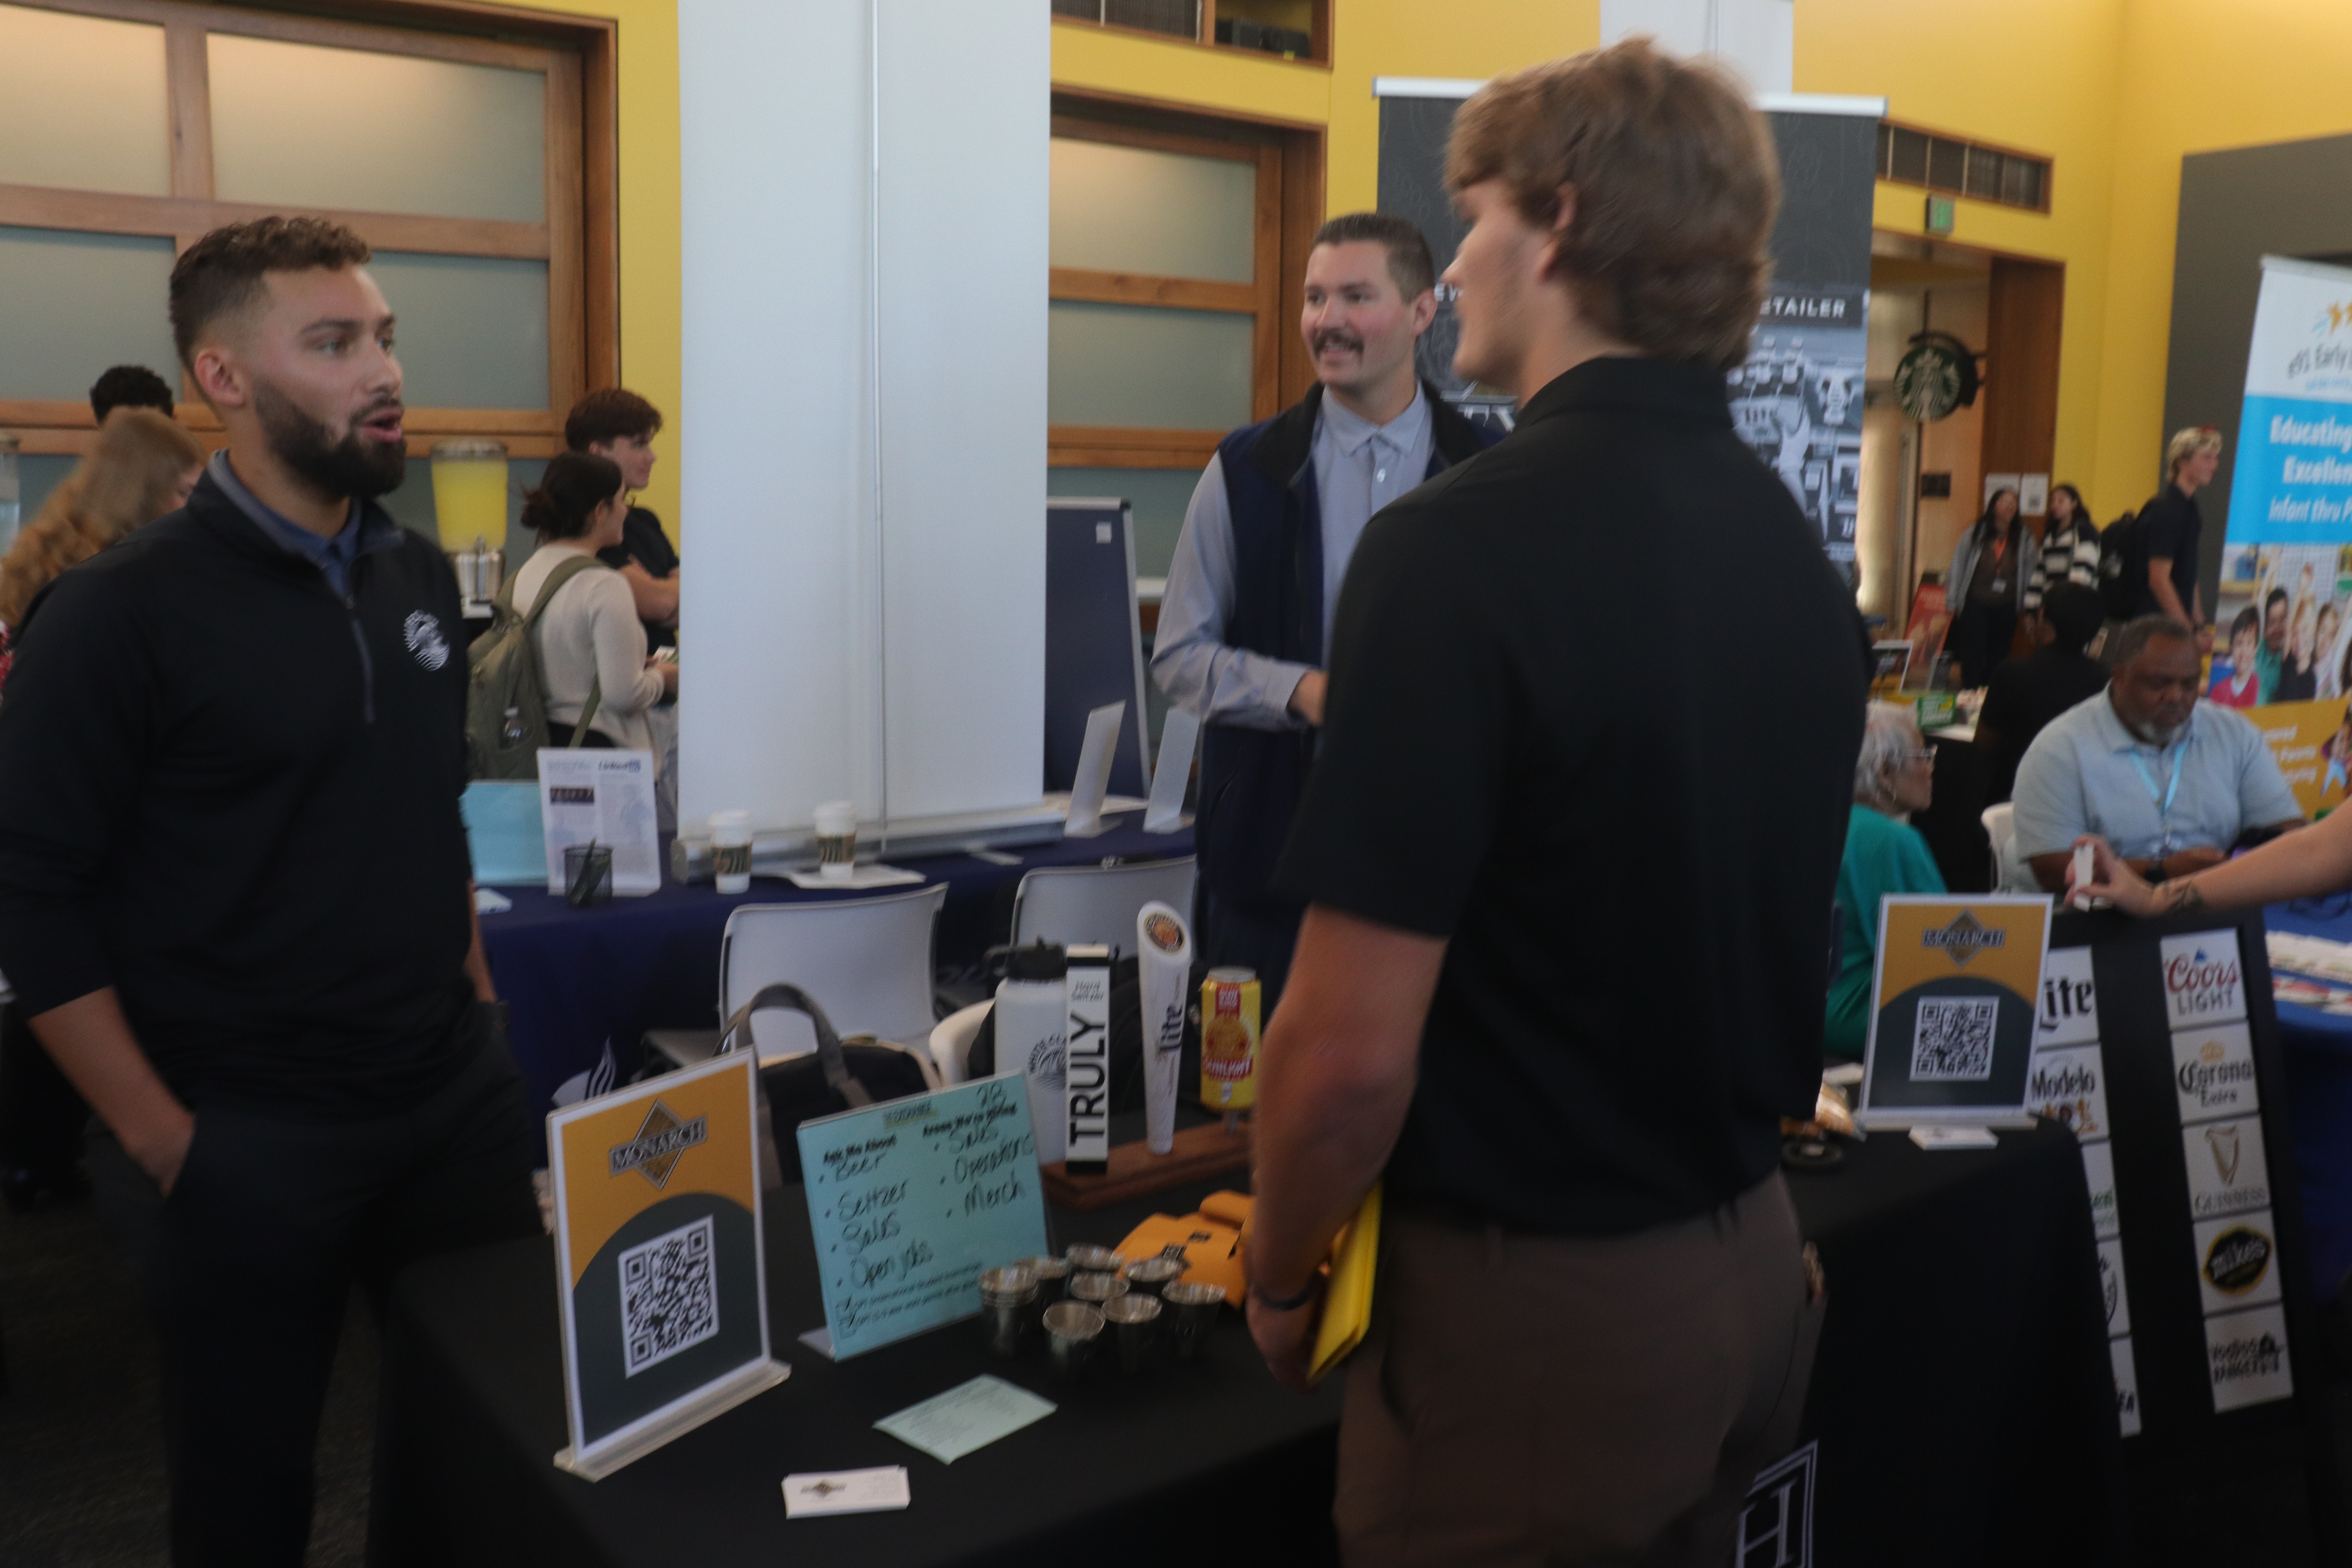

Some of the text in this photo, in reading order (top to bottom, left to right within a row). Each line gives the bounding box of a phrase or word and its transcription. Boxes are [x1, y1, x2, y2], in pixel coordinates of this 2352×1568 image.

[1760, 295, 1846, 318] ETAILER
[1925, 930, 2003, 946] MONARCH
[2165, 956, 2238, 994] Coors
[2178, 985, 2234, 1016] LIGHT
[1069, 1011, 1107, 1147] TRULY
[2031, 1062, 2095, 1100] Modelo
[614, 1118, 704, 1170] MONARCH
